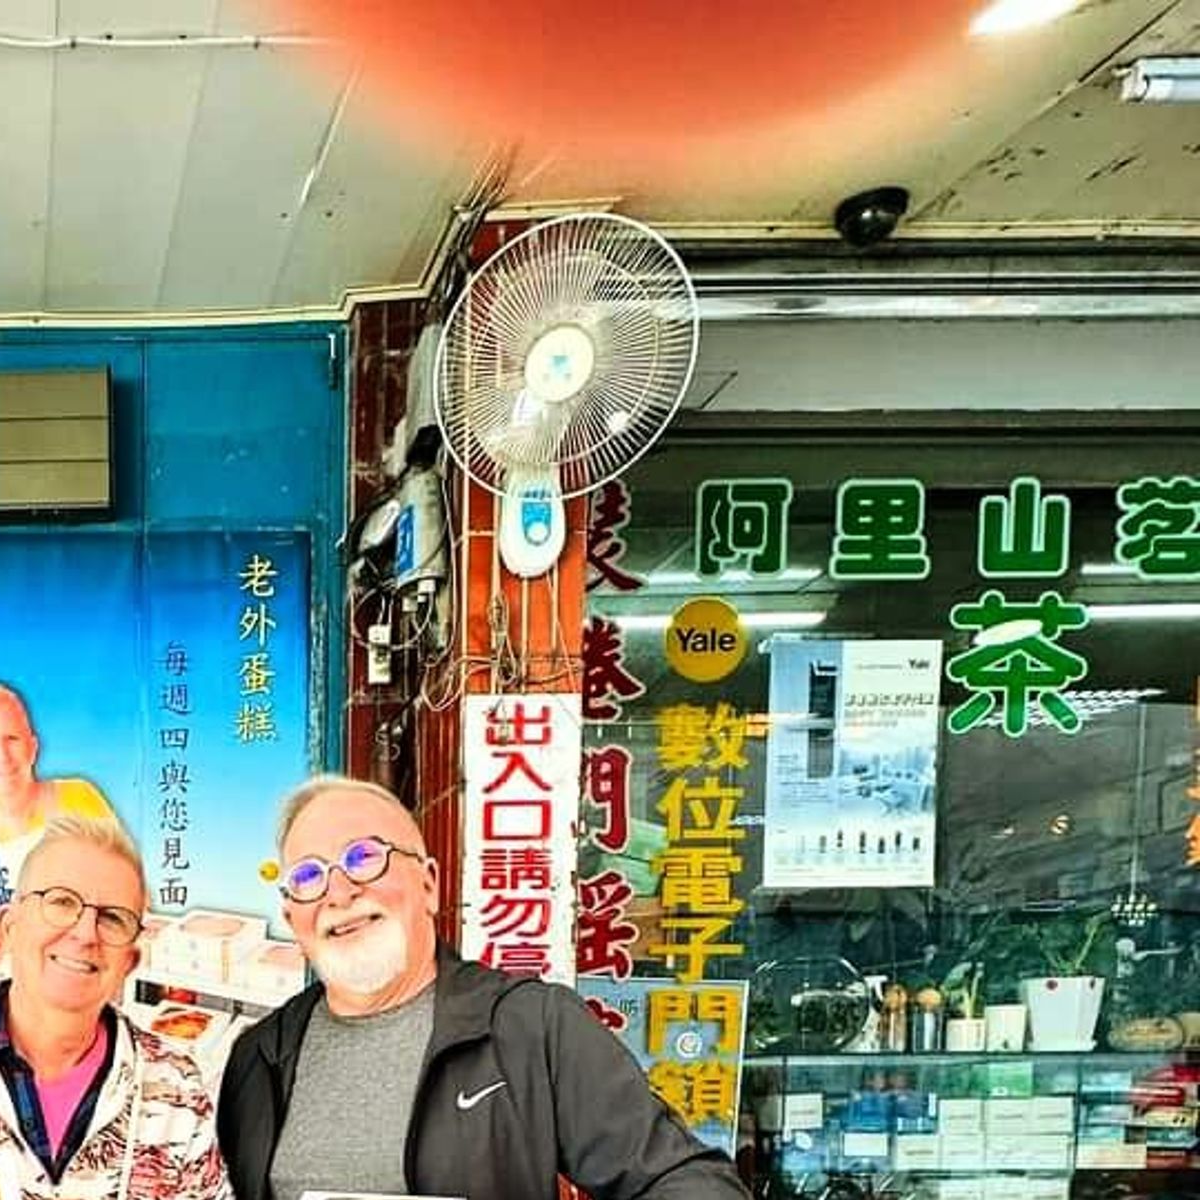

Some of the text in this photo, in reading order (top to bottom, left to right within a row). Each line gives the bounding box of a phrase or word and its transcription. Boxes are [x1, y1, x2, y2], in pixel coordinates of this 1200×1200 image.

[697, 477, 1200, 580] 阿里山茗
[235, 554, 279, 743] 老外蛋糕
[676, 626, 737, 653] Yale
[946, 590, 1090, 738] 茶
[159, 640, 192, 906] 每週四與您見面
[647, 702, 749, 1129] 數位電子門鎖
